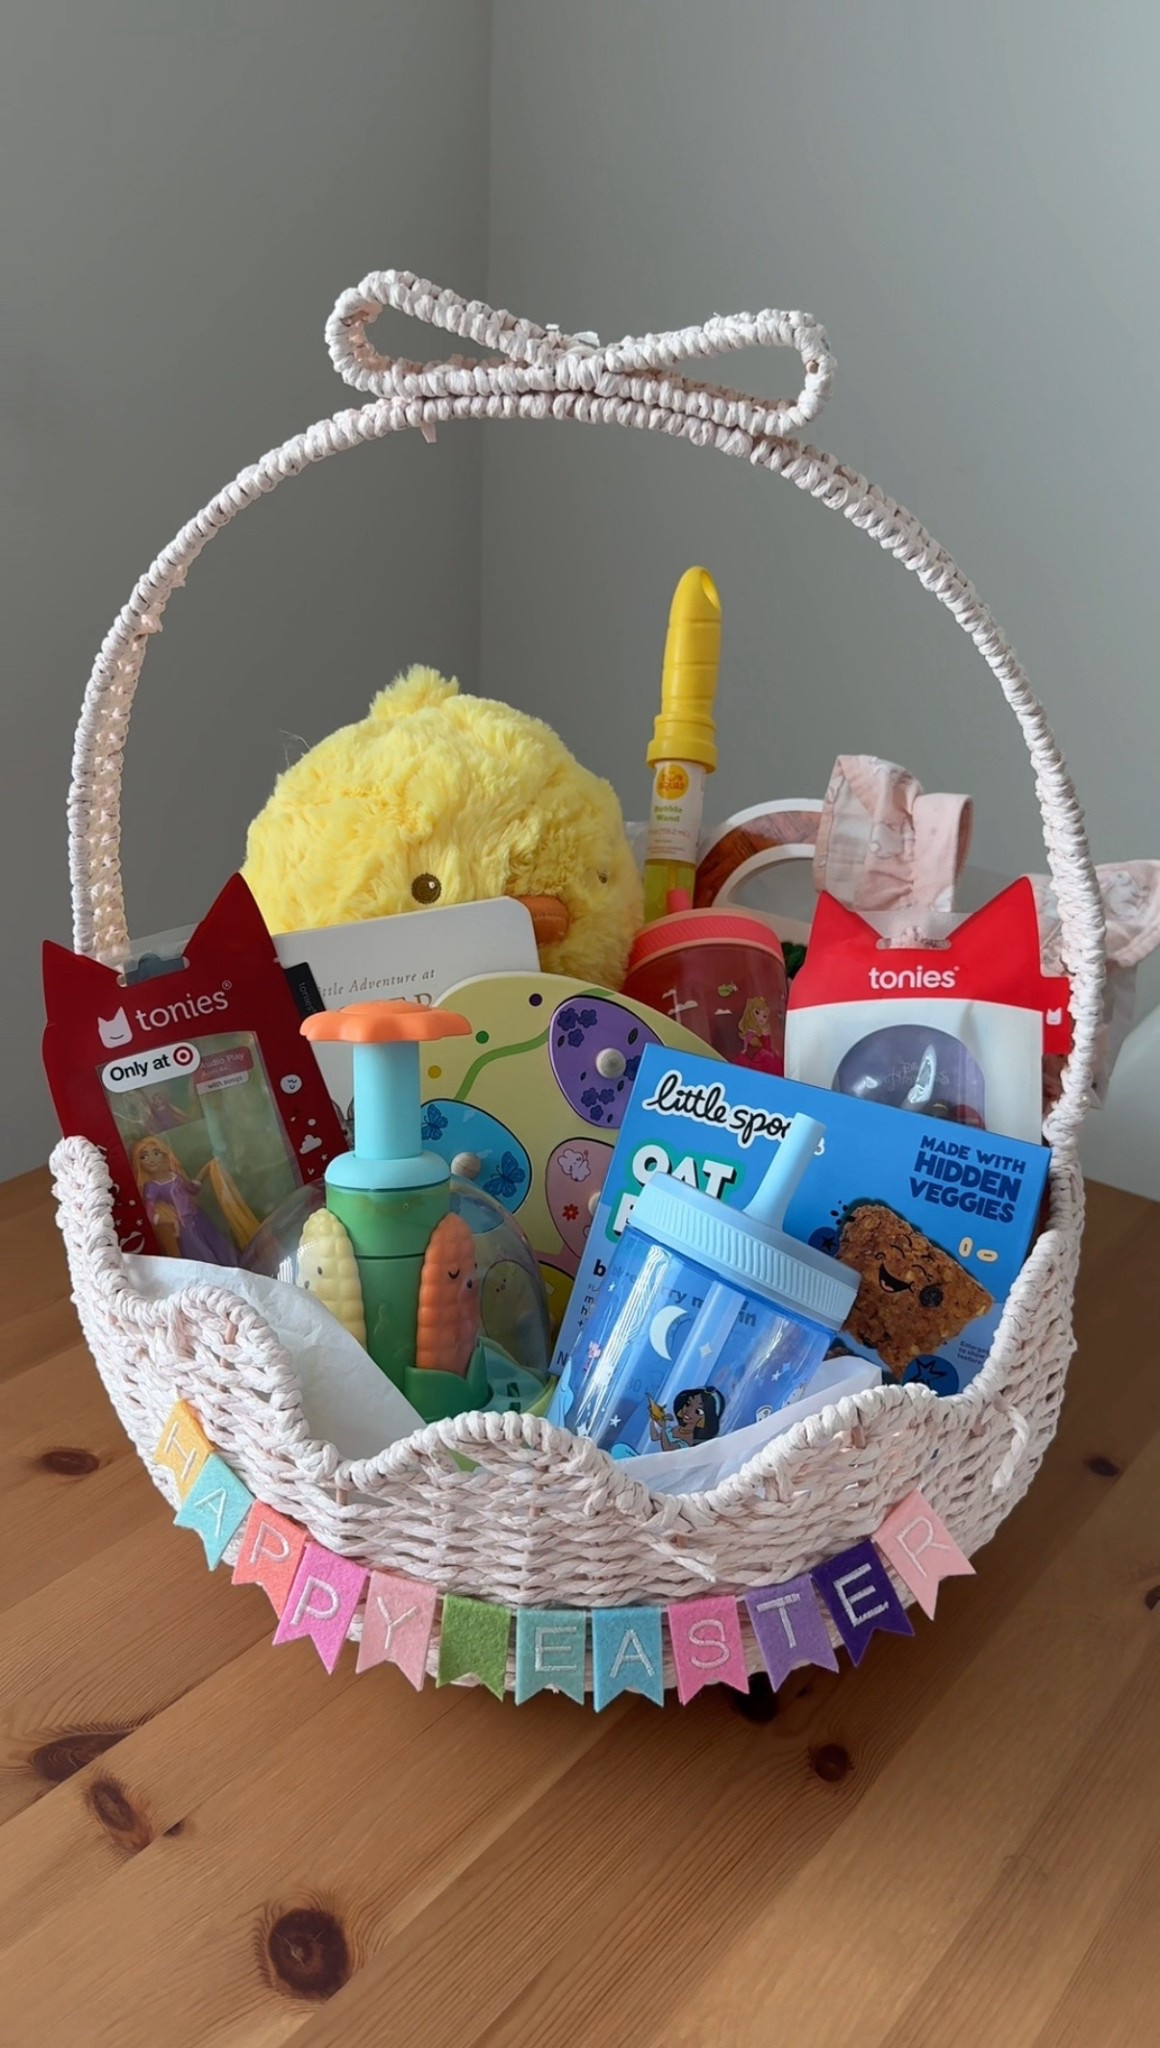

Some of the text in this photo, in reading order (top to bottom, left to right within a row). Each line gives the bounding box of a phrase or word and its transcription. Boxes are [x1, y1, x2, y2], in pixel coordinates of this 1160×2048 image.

[317, 969, 435, 998] ittle Adventure at
[869, 966, 956, 989] tonies
[110, 1054, 170, 1082] Only at
[646, 1073, 805, 1146] little spo
[920, 1135, 1026, 1174] MADE WITH
[914, 1151, 1022, 1203] HIDDEN
[909, 1177, 1015, 1223] VEGGIES
[164, 1421, 951, 1679] HAPPY EASTER
